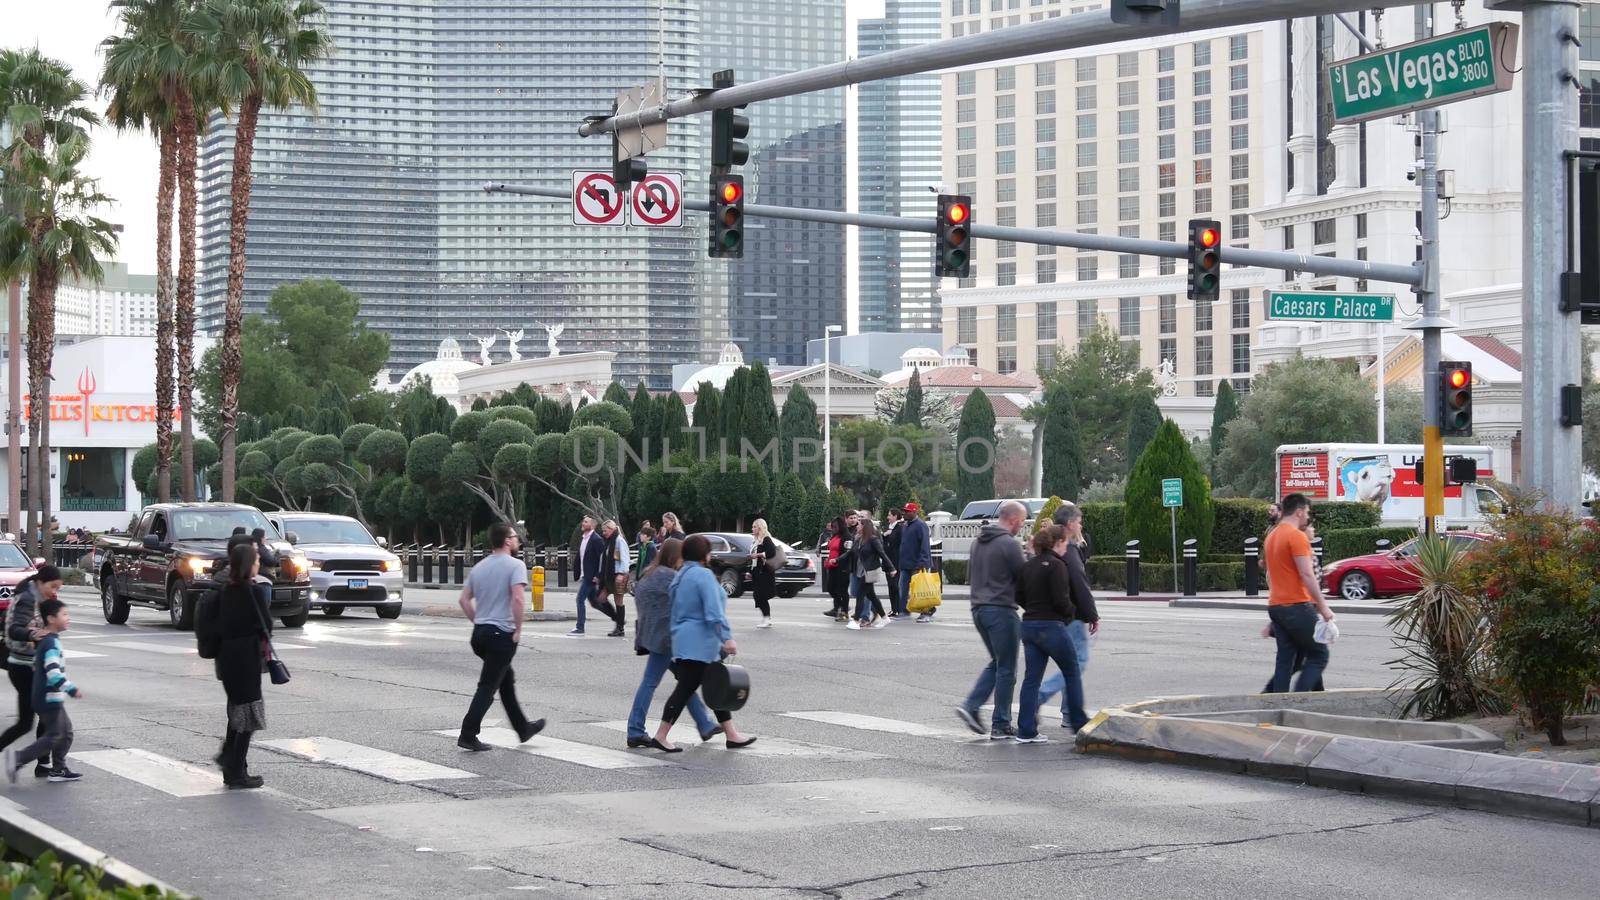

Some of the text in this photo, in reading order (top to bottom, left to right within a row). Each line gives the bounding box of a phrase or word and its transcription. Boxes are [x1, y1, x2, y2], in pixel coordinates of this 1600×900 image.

[1458, 39, 1485, 62] BLVD
[1335, 48, 1459, 103] S Las Vegas
[1461, 60, 1489, 83] 3800
[1274, 296, 1391, 317] Caesars Palace DR
